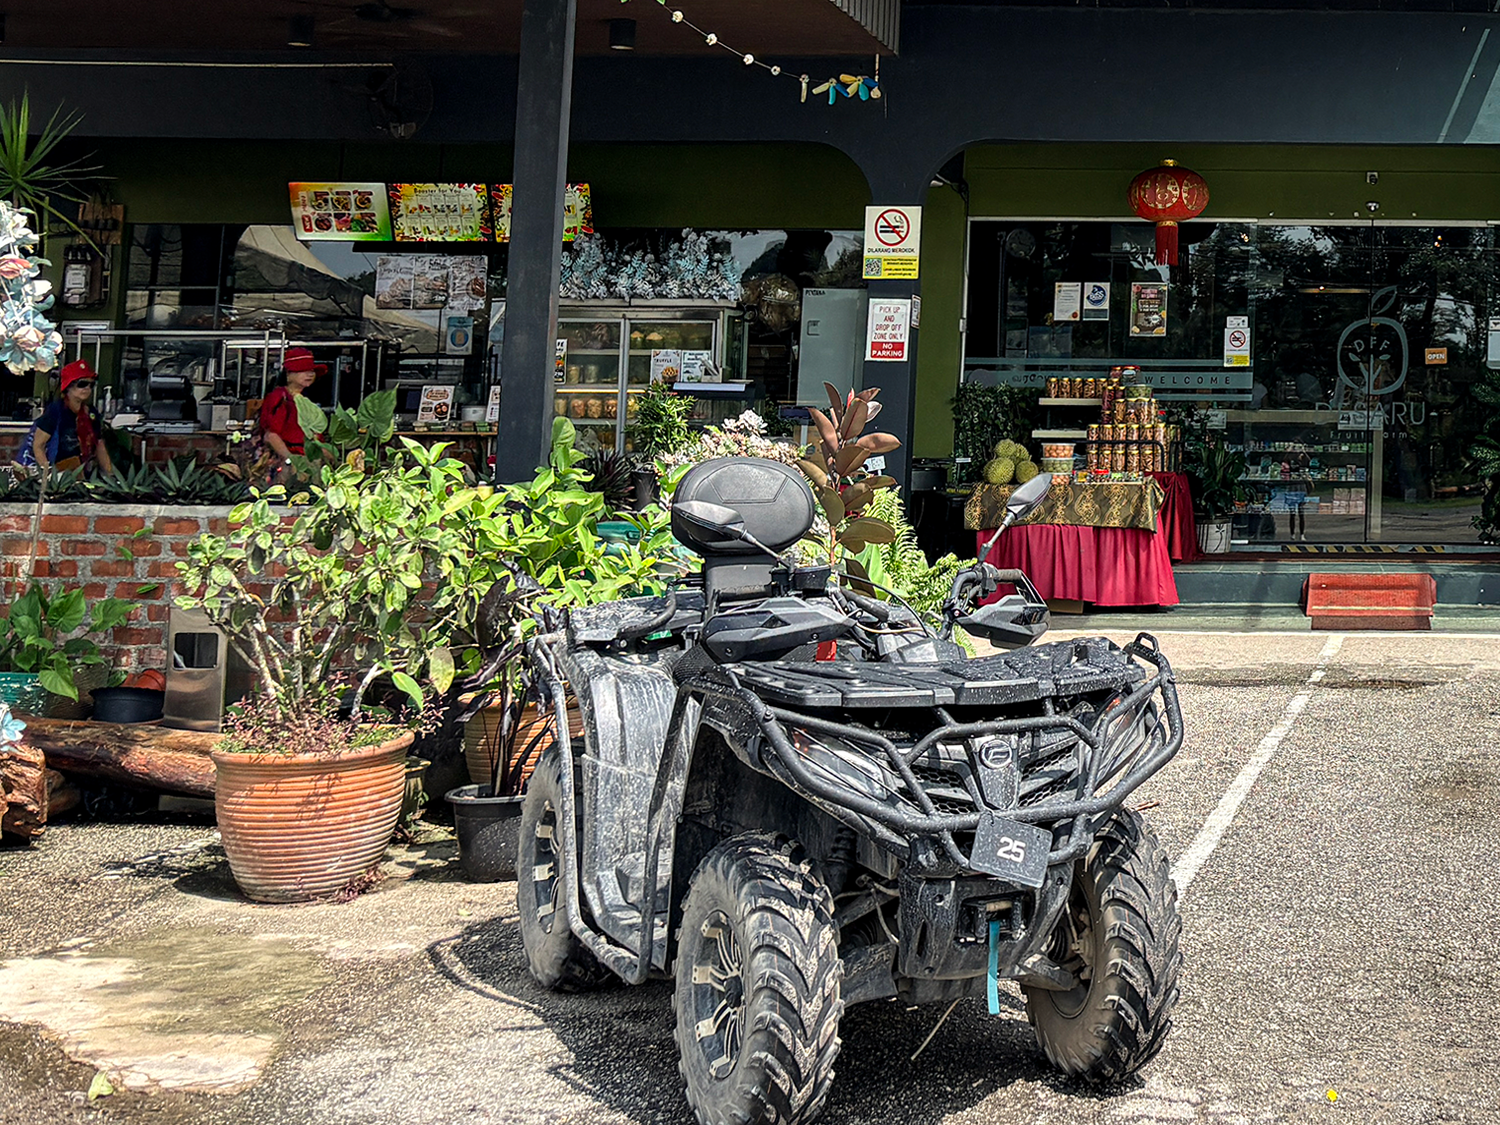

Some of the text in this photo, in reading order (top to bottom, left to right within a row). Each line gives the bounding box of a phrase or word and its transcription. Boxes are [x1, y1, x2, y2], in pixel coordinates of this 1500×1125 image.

[1354, 336, 1390, 352] DFF
[1145, 376, 1231, 385] WELCOME
[997, 836, 1026, 863] 25
